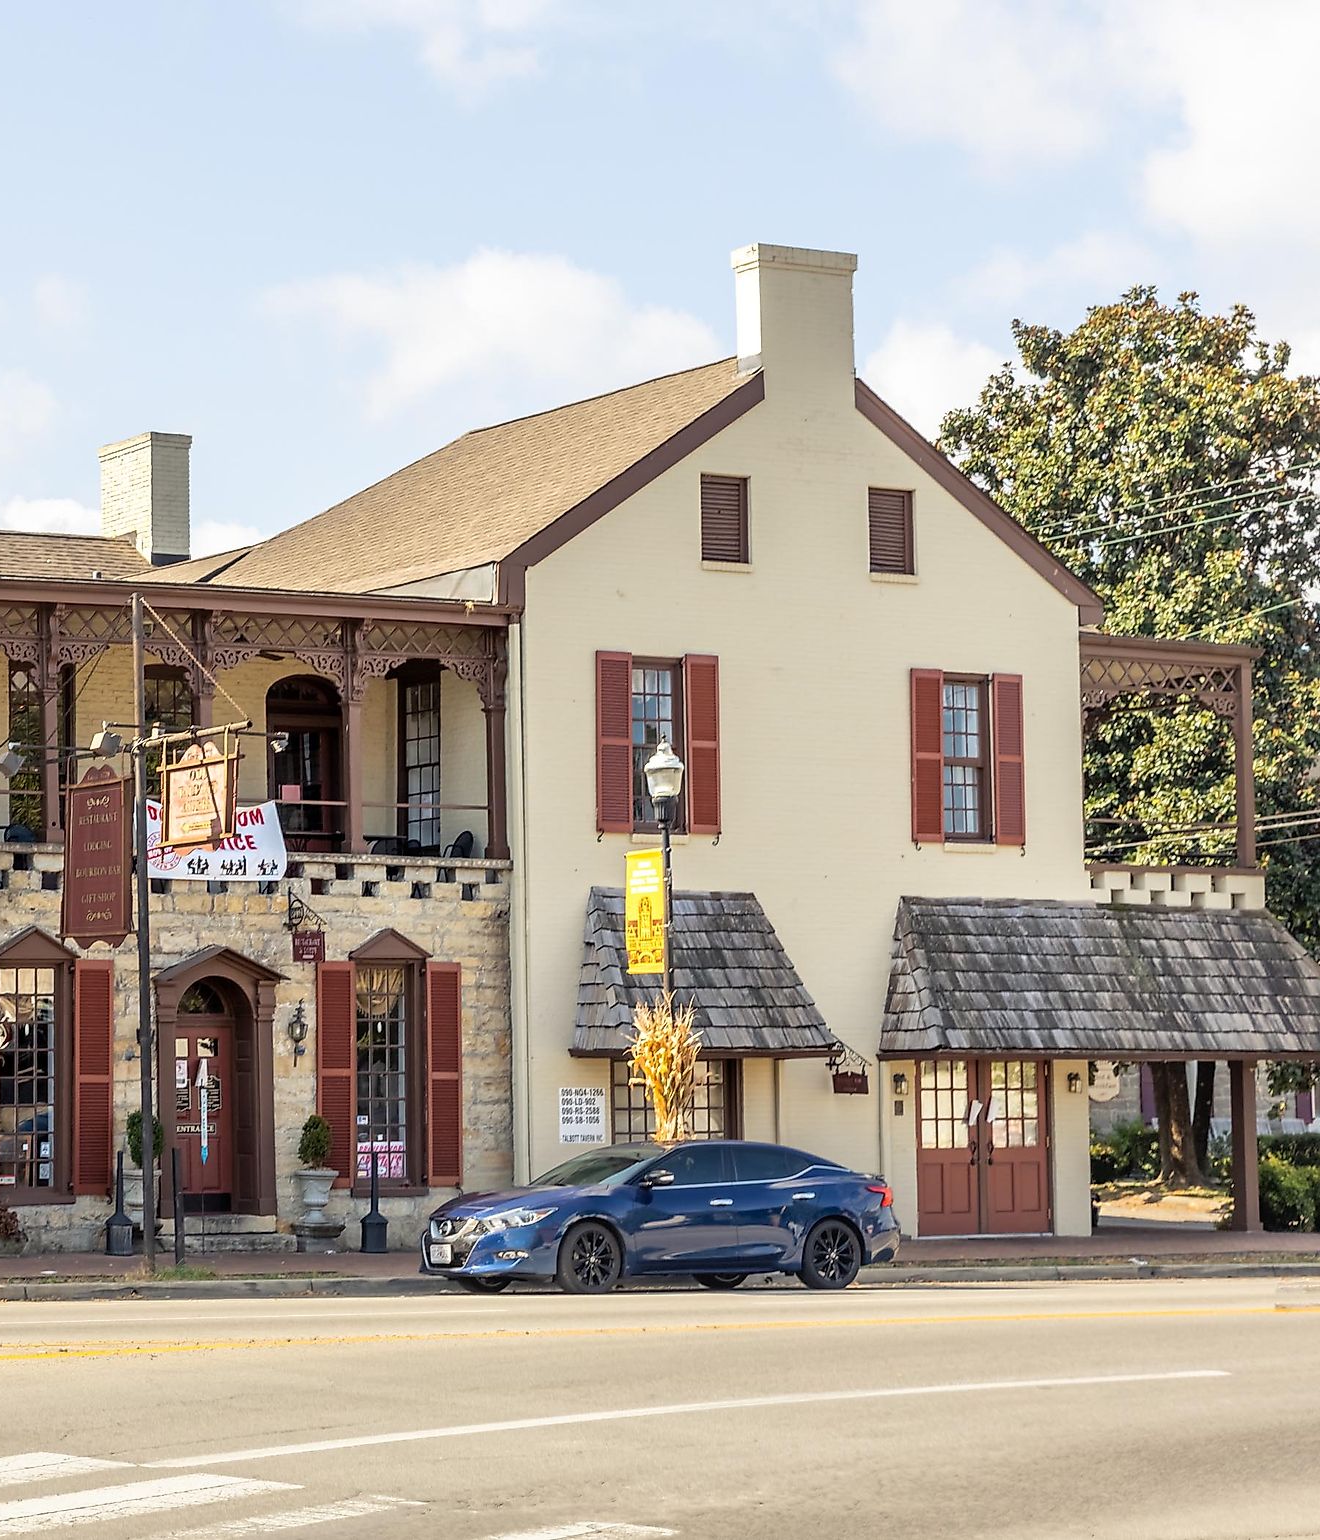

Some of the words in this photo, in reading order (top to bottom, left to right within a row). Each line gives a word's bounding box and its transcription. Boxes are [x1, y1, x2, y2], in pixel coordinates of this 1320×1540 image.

[78, 812, 118, 826] RESTAURANT
[83, 839, 113, 852] LODGING
[75, 867, 107, 878] BOURBON
[108, 865, 121, 875] BAR
[81, 893, 97, 904] GIFT
[97, 892, 116, 903] SHOP
[176, 1125, 215, 1133] ENTRAE
